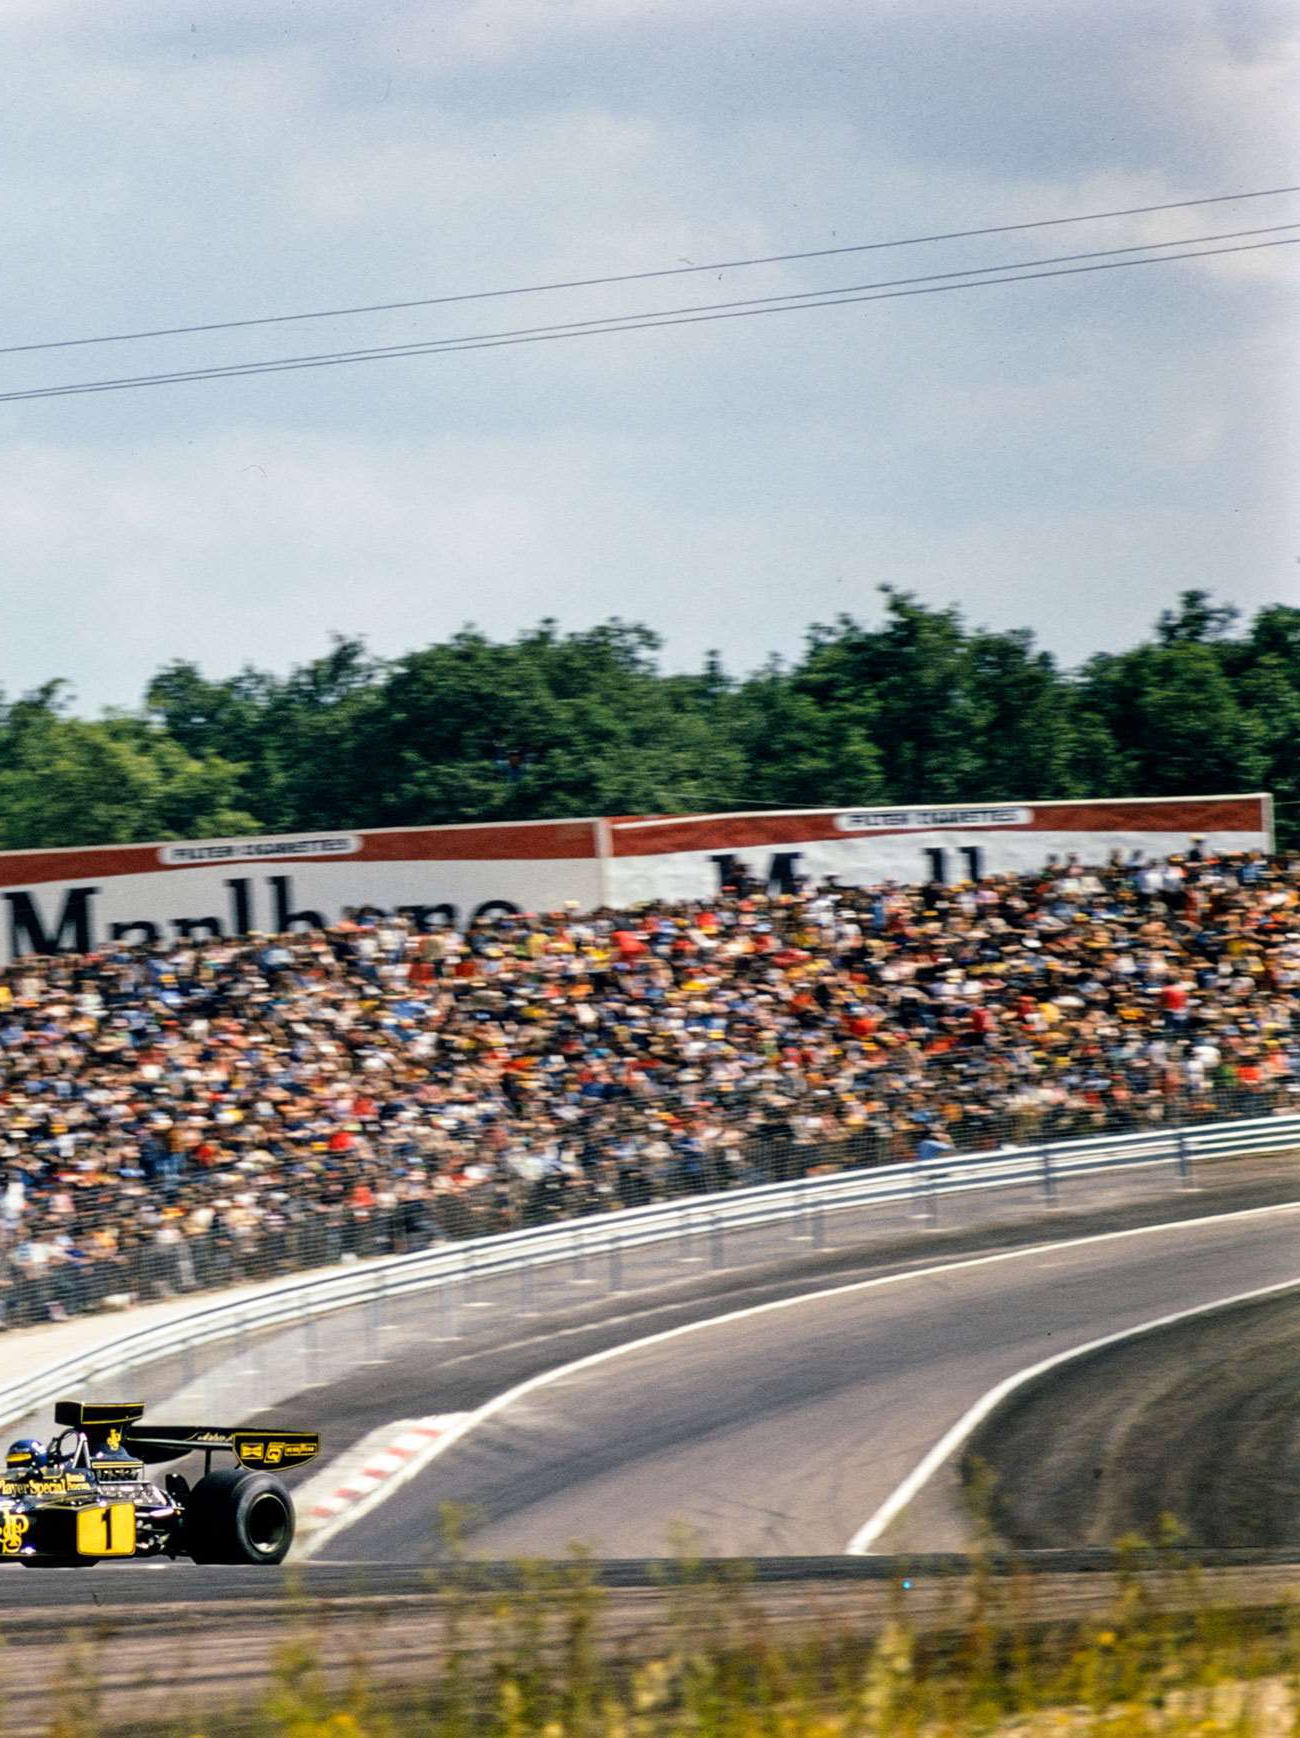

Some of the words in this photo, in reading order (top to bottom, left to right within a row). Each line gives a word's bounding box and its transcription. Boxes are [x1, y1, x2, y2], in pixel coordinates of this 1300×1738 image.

[0, 874, 524, 958] Marlbro
[29, 1478, 68, 1497] Special
[100, 1507, 114, 1551] 1
